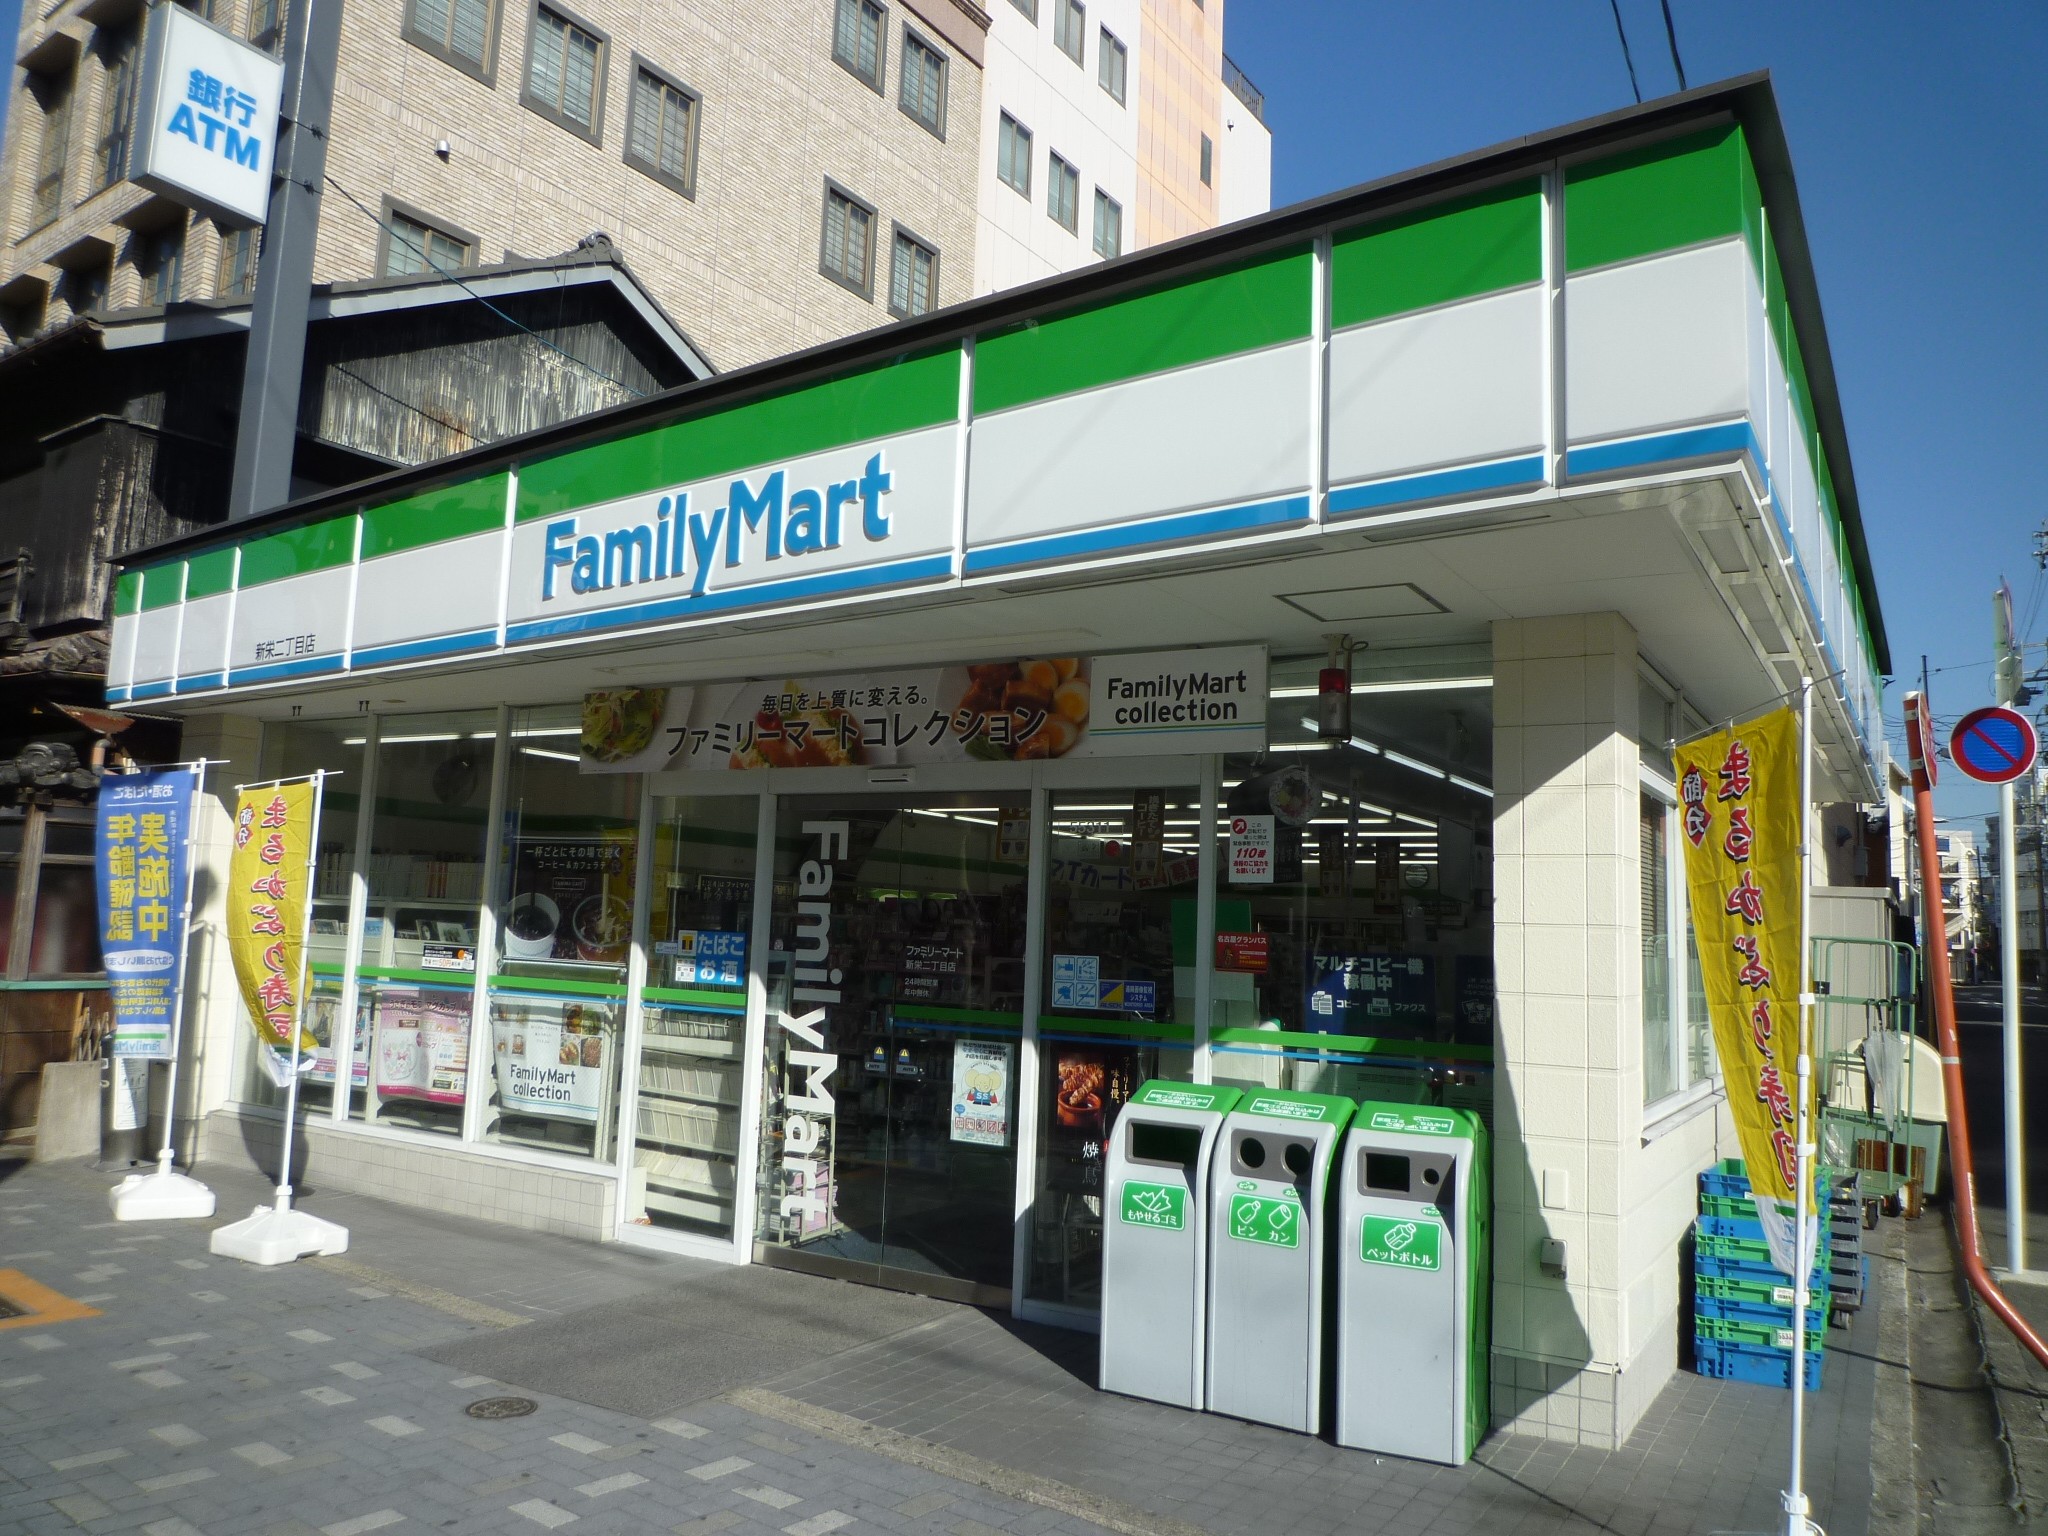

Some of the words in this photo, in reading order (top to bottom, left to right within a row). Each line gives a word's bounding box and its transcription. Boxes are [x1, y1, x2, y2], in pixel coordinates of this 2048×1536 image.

[187, 66, 257, 130] 銀行
[166, 104, 260, 173] ATM
[543, 451, 893, 600] FamilyMart
[255, 632, 317, 662] 新栄二丁目店
[1106, 670, 1248, 702] FamilyMart
[761, 686, 929, 714] 毎日を上質に変える。
[1113, 697, 1238, 725] collection
[665, 707, 1048, 756] ファミリーマートコレクション
[1236, 848, 1267, 859] 110番
[697, 934, 744, 956] たばこ
[1217, 935, 1267, 945] 名古屋グランパス
[906, 945, 964, 960] ファミリーマート
[699, 959, 739, 983] お酒
[905, 959, 957, 972] 新栄二丁目店
[1313, 955, 1425, 975] マルチコピー機
[904, 977, 939, 987] 24時間営業
[1343, 973, 1393, 992] 稼働中
[904, 988, 930, 998] 年中無休
[1130, 994, 1148, 1002] システム
[1336, 999, 1360, 1009] コピー
[1394, 1002, 1426, 1013] ファクス
[777, 820, 849, 1222] FamilyMart
[510, 1064, 576, 1085] FamilyMart
[513, 1082, 571, 1102] collection
[1126, 1208, 1178, 1226] もやせるゴミ
[1236, 1224, 1258, 1238] ビン
[1268, 1230, 1290, 1244] カン
[1366, 1248, 1433, 1266] ペットボトル
